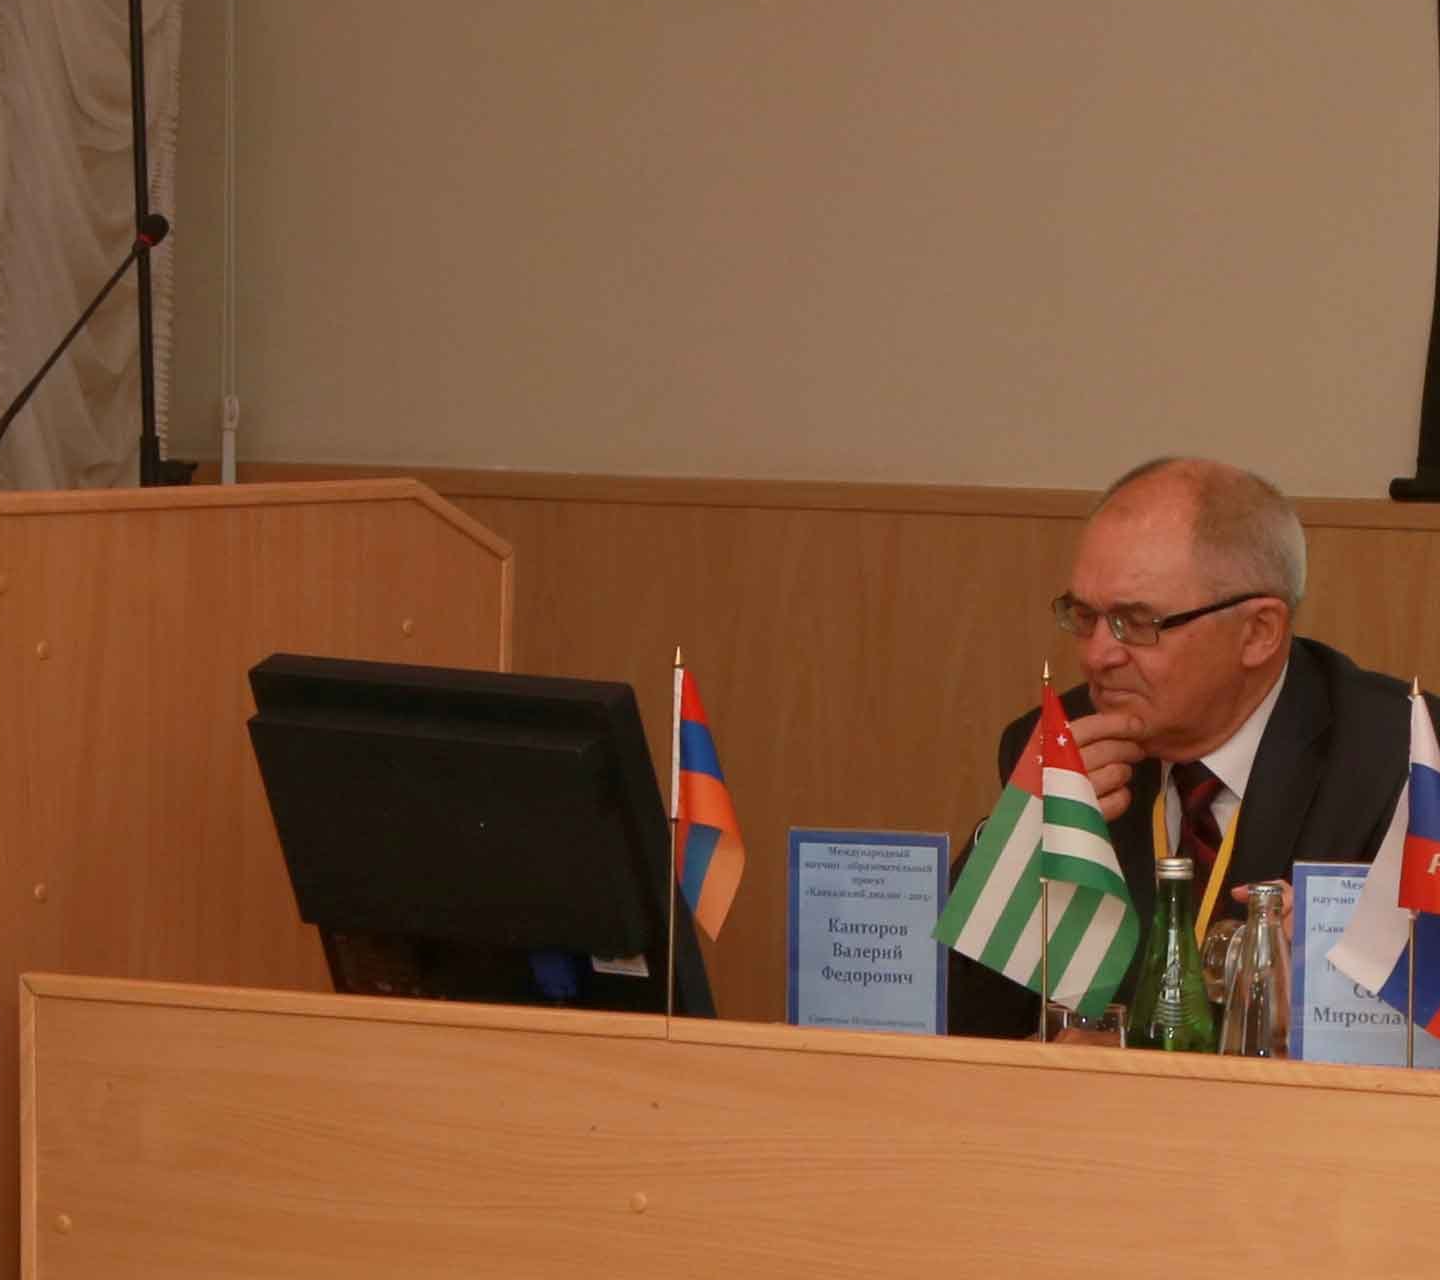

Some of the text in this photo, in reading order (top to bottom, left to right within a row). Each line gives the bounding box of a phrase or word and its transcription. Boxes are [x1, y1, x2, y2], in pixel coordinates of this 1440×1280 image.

[827, 917, 909, 939] Канторов
[832, 940, 904, 964] Валерий
[820, 965, 914, 987] Федорович
